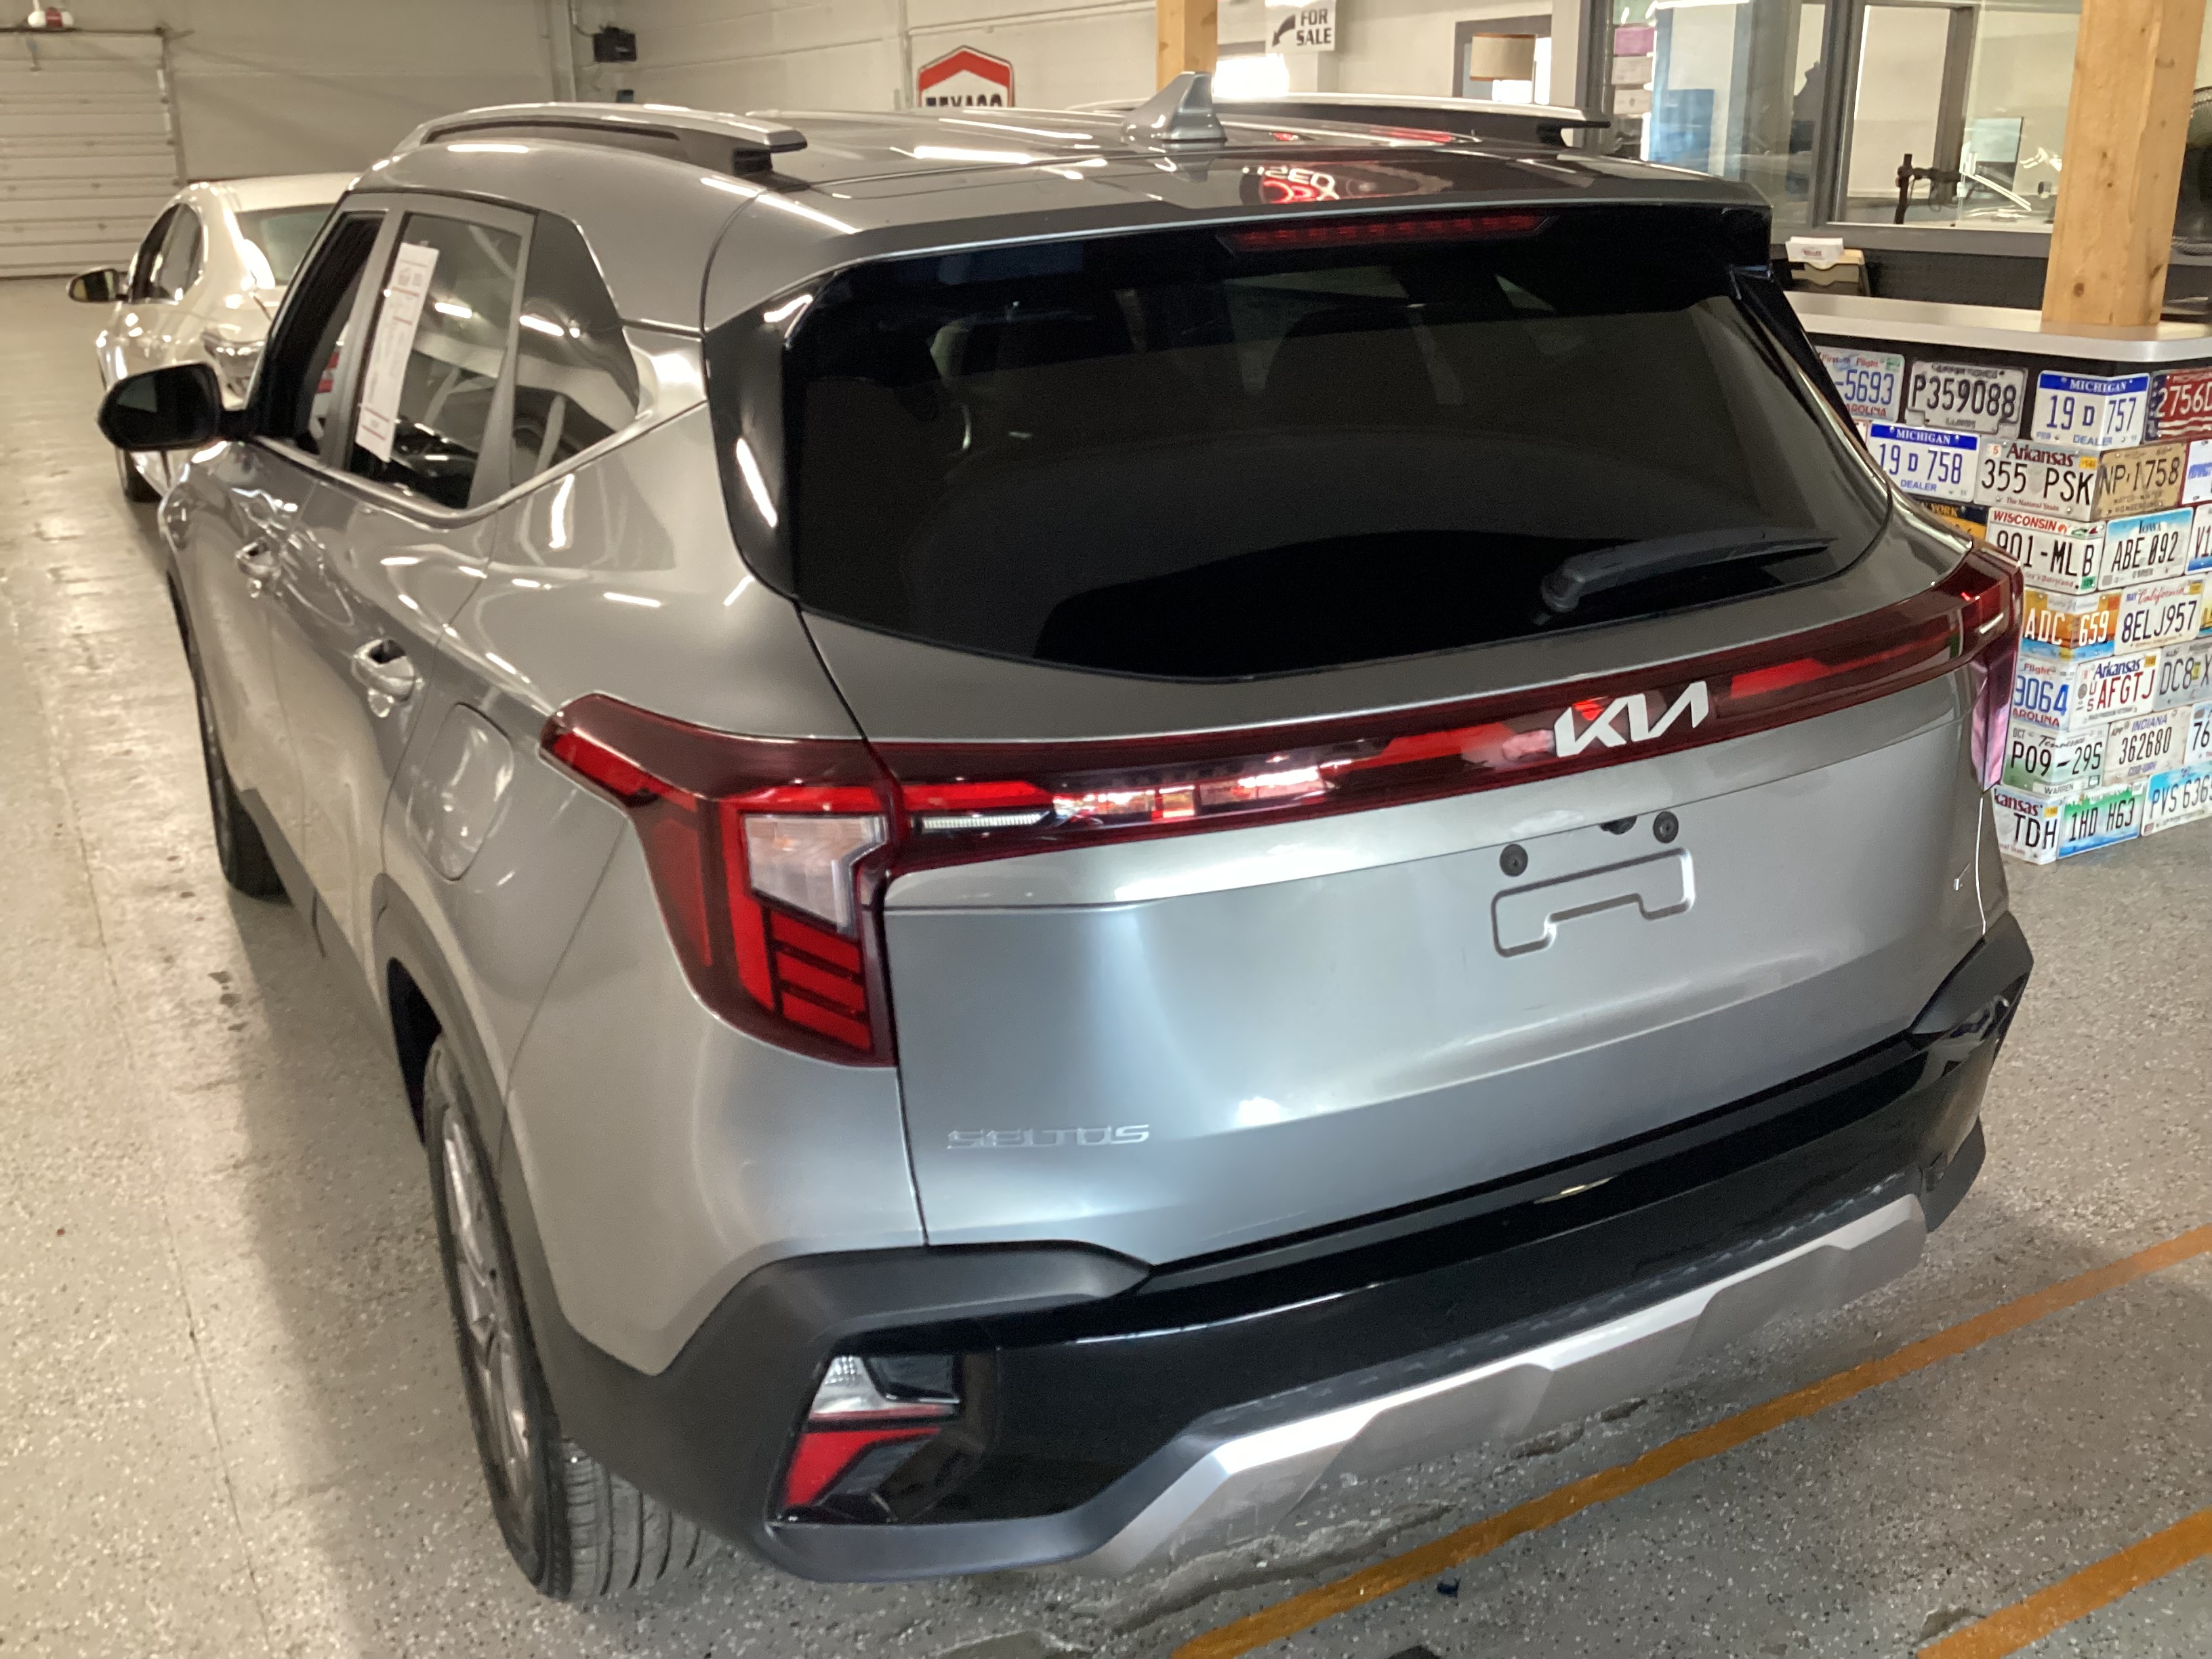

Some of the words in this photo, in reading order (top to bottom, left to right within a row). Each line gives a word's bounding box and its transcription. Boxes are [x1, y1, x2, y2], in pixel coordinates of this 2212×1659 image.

[1300, 8, 1328, 26] FOR
[1296, 27, 1332, 46] SALE
[1912, 373, 2016, 418] P359088
[2070, 380, 2127, 392] MICHIGAN
[2047, 395, 2075, 430] 19
[2082, 405, 2095, 426] D
[2107, 397, 2137, 434] 757
[1896, 428, 1951, 445] MICHIGAN
[2073, 434, 2112, 446] DEALER
[1879, 443, 1901, 475] 19
[1908, 453, 1919, 472] D
[1927, 449, 1963, 484] 758
[2006, 443, 2075, 467] Arkansas
[1900, 479, 1937, 492] DEALER
[1982, 459, 2028, 494] 355
[2043, 468, 2095, 506] PSK
[1993, 510, 2057, 531] WISCONSIN
[2111, 537, 2145, 572] ABE
[2138, 586, 2185, 606] California
[2024, 608, 2066, 645] ADC
[2078, 610, 2110, 646] 659
[2121, 600, 2198, 643] 8ELJ957
[2024, 663, 2050, 675] Flight
[2093, 658, 2142, 680] Arkansas
[1554, 680, 1709, 758] KIA
[2131, 714, 2168, 733] INDIANA
[2013, 727, 2026, 739] OCT
[2119, 726, 2173, 765] 362680
[2045, 783, 2074, 795] WARREN
[2150, 783, 2179, 819] PVS
[2014, 813, 2058, 850] TDH
[947, 1124, 1149, 1150] SELTOS
